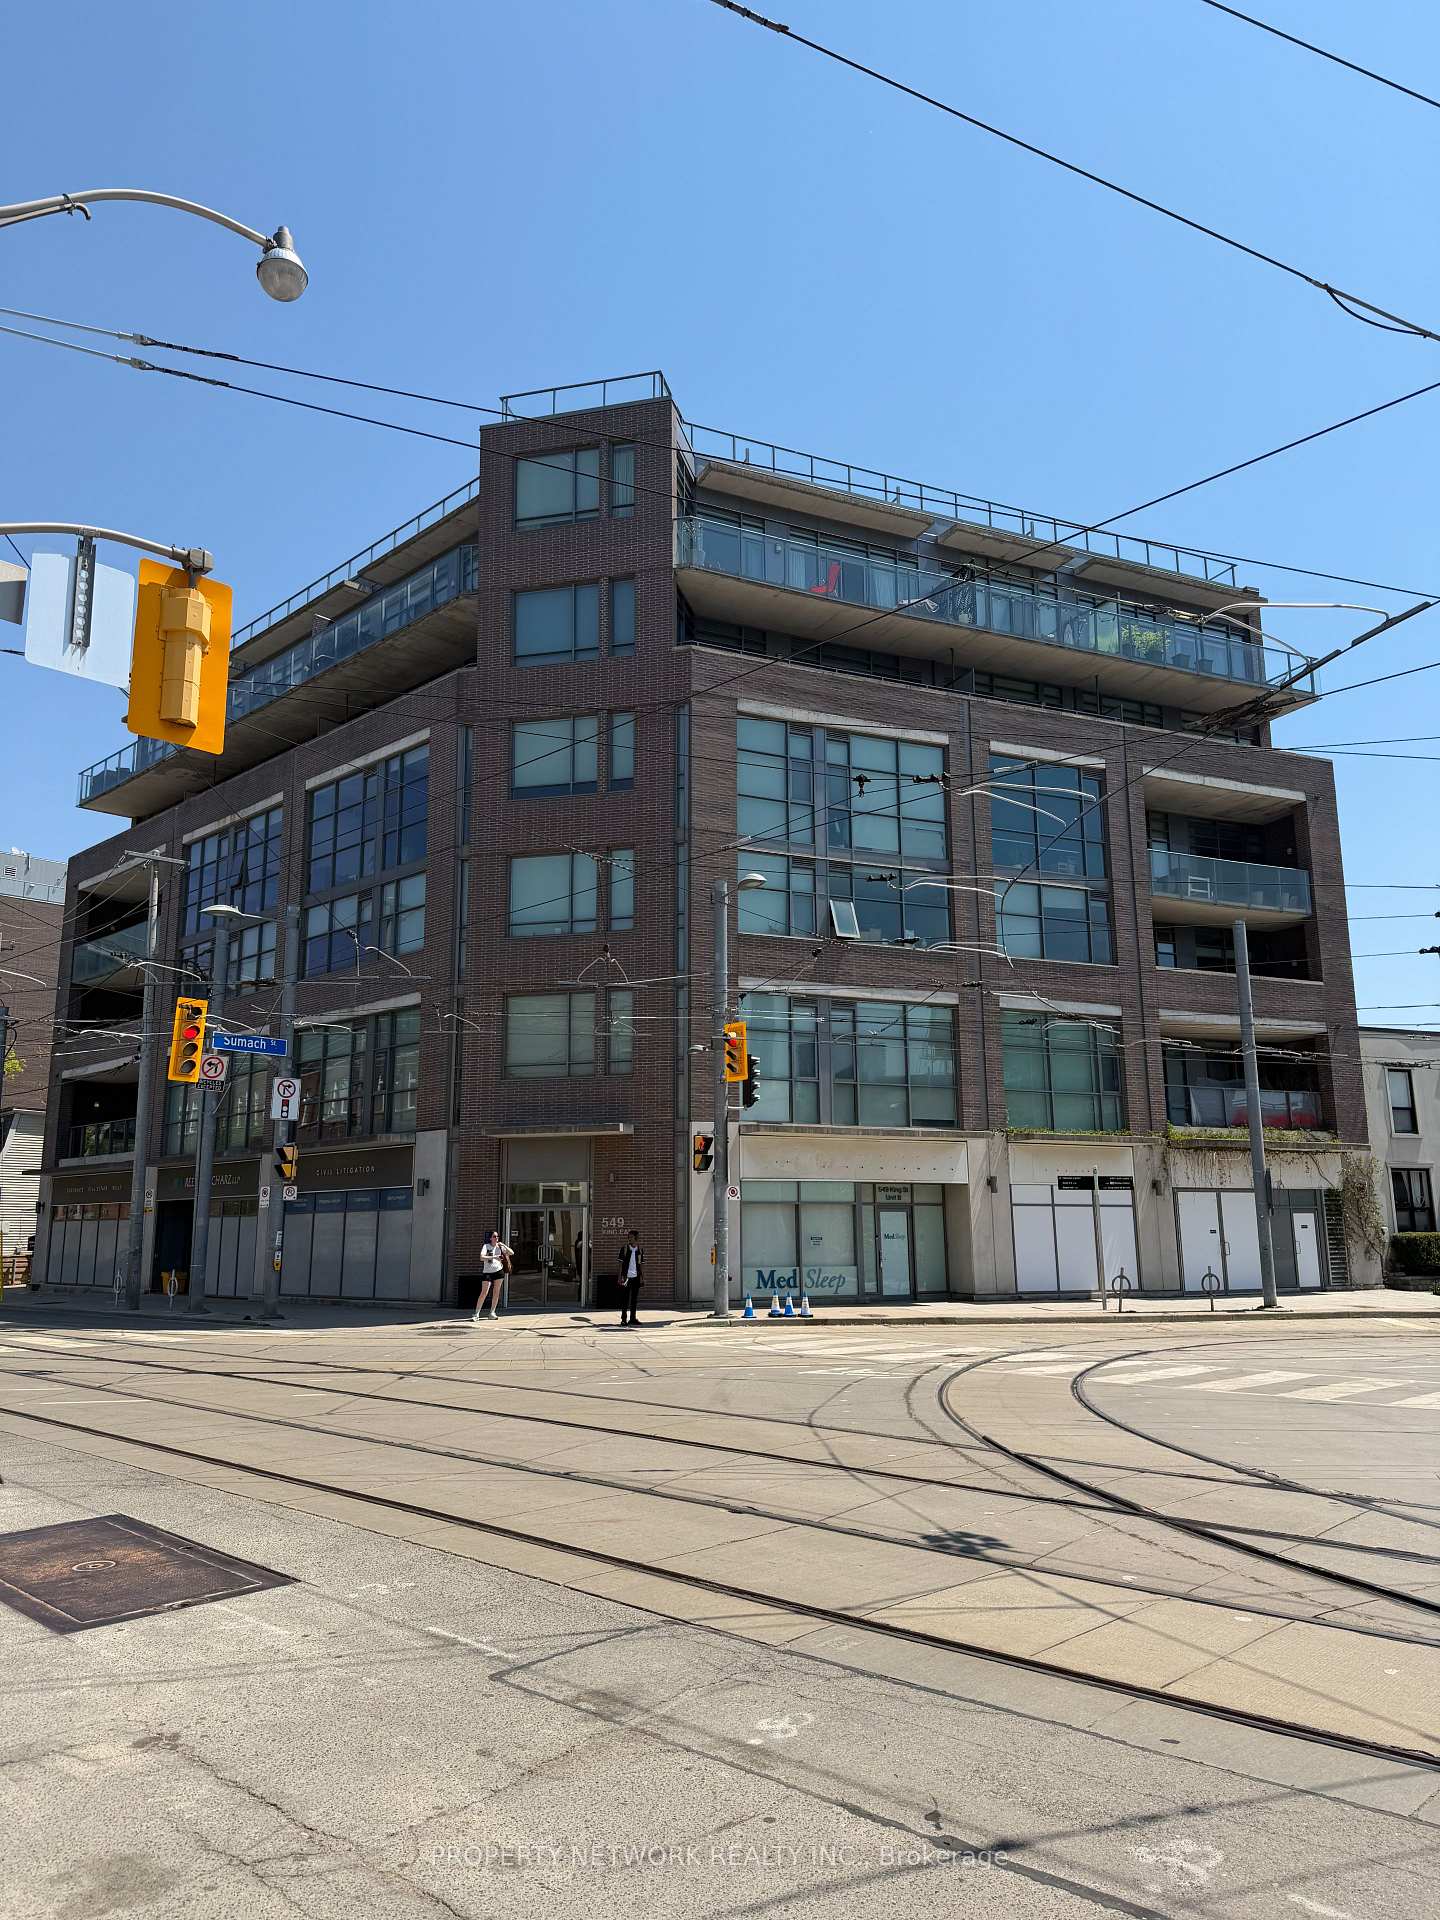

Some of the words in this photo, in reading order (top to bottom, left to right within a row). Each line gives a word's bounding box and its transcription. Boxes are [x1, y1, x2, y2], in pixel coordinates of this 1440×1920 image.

[223, 1036, 267, 1050] Sumach
[336, 1165, 376, 1175] LITIGATION
[601, 1216, 625, 1229] 549
[756, 1268, 799, 1290] Med
[804, 1267, 846, 1295] Sleep
